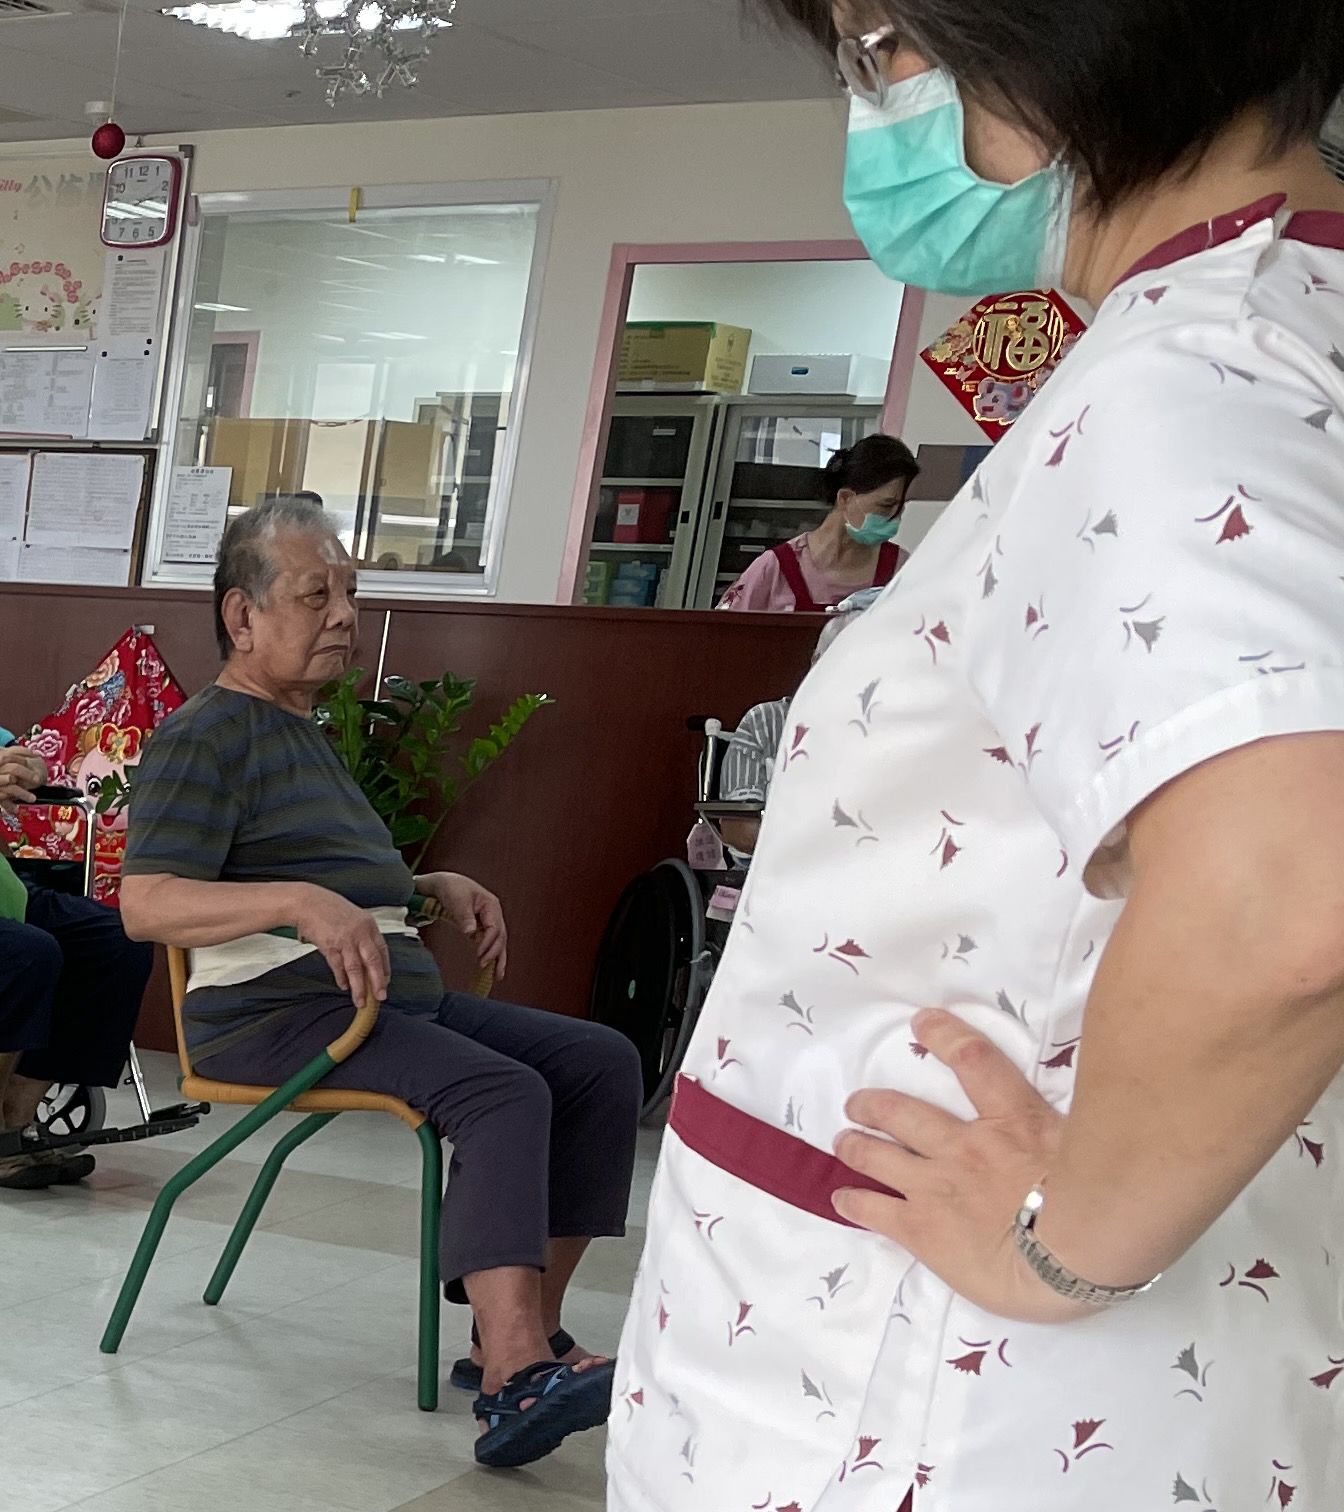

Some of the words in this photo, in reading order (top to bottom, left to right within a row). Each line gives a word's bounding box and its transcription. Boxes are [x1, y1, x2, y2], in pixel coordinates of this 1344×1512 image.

[124, 167, 134, 178] 11
[139, 166, 149, 176] 12
[161, 180, 169, 191] 2
[132, 228, 140, 238] 6
[148, 226, 155, 237] 5
[976, 300, 1050, 371] 福
